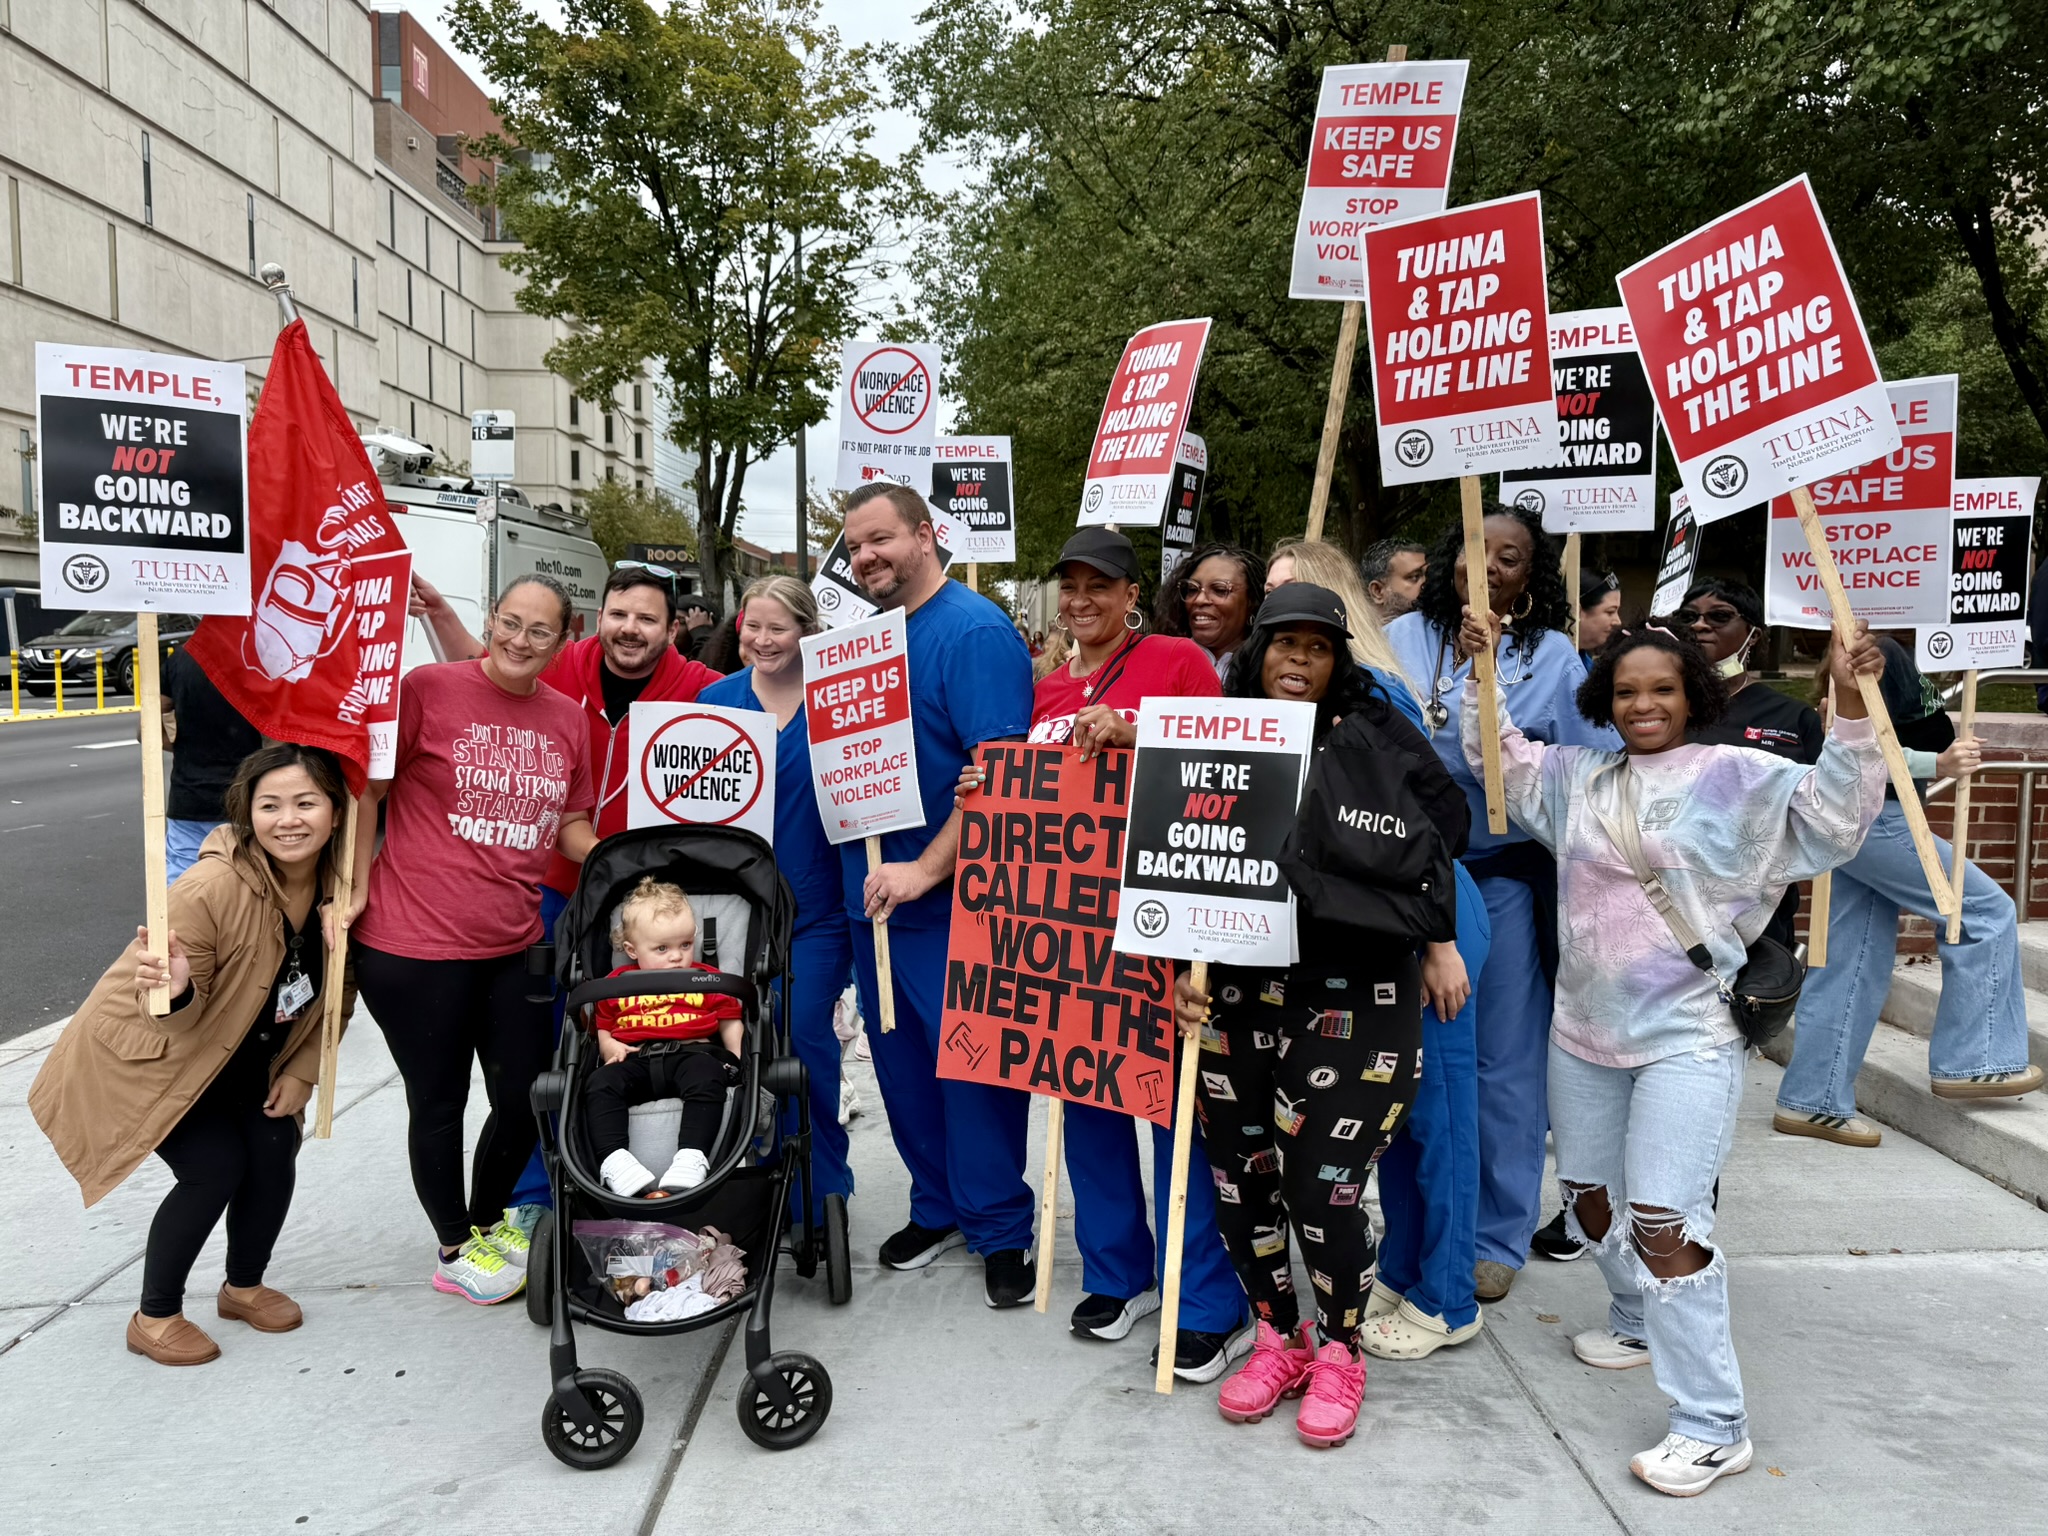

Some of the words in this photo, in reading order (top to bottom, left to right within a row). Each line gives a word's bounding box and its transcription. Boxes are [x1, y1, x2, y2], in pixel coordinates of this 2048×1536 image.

[1340, 81, 1443, 106] TEMPLE
[1324, 126, 1394, 150] KEEP
[1402, 126, 1442, 150] US
[1340, 154, 1414, 178] SAFE
[1346, 198, 1398, 215] STOP
[1317, 244, 1362, 260] VIOL
[1397, 228, 1506, 283] TUHNA
[1658, 224, 1784, 313] TUHNA
[1408, 286, 1430, 320] &
[1438, 273, 1500, 316] TAP
[1683, 306, 1709, 345] &
[1713, 270, 1784, 330] TAP
[1386, 308, 1532, 365] HOLDING
[1666, 295, 1832, 400] HOLDING
[1125, 341, 1182, 375] TUHNA
[65, 363, 221, 406] TEMPLE,
[860, 370, 924, 392] WORKPLACE
[1122, 378, 1135, 404] &
[1134, 372, 1170, 400] TAP
[1394, 362, 1452, 402] THE
[1458, 349, 1532, 392] LINE
[1554, 364, 1611, 390] WE'RE
[1683, 374, 1751, 434] THE
[1756, 334, 1843, 404] LINE
[865, 393, 916, 414] VIOLENCE
[1556, 392, 1600, 416] NOT
[100, 413, 188, 446] WE'RE
[1102, 402, 1177, 436] HOLDING
[1450, 416, 1542, 446] TUHNA
[1560, 417, 1610, 442] OING
[1762, 406, 1874, 460] TUHNA
[474, 427, 488, 440] 16
[1476, 441, 1511, 450] UNIVERSITY
[1512, 437, 1540, 446] HOSPITAL
[1771, 454, 1796, 469] TEMPLE
[1796, 438, 1839, 458] UNIVERSITY
[1840, 426, 1874, 442] HOSPITAL
[112, 446, 176, 474] NOT
[842, 440, 856, 452] IT'S
[857, 442, 872, 454] NOT
[874, 444, 892, 454] PART
[894, 445, 902, 455] OF
[904, 446, 917, 456] THE
[918, 446, 931, 456] JOB
[935, 445, 999, 458] TEMPLE,
[1097, 436, 1128, 464] THE
[1124, 432, 1170, 460] LINE
[1490, 445, 1529, 455] ASSOCIATION
[1787, 455, 1814, 470] NURSES
[1816, 438, 1862, 459] ASSOCIATION
[1886, 445, 1936, 472] US
[950, 468, 986, 481] WE'RE
[94, 474, 190, 506] GOING
[437, 493, 480, 505] FRONTLINE
[956, 483, 982, 496] NOT
[1112, 484, 1156, 500] TUHNA
[1562, 486, 1638, 505] TUHNA
[1813, 476, 1903, 506] SAFE
[1954, 492, 2022, 512] EMPLE,
[949, 498, 988, 511] GOING
[58, 502, 232, 539] BACKWARD
[1826, 522, 1892, 542] STOP
[966, 537, 1006, 547] TUHNA
[1957, 526, 2004, 547] WE'RE
[132, 560, 230, 583] TUHNA
[536, 558, 582, 578] nbc10.com
[1961, 550, 1997, 570] NOT
[564, 582, 596, 600] 62.com
[1796, 570, 1920, 591] VILENCE
[1951, 571, 2002, 592] GOING
[1952, 592, 2020, 614] CKWARD
[816, 629, 892, 669] TEMPLE
[1967, 630, 2016, 646] TUHNA
[813, 677, 866, 710] KEEP
[872, 667, 900, 694] US
[831, 696, 886, 730] SAFE
[1160, 714, 1286, 746] TEMPLE,
[453, 738, 537, 774] STAND
[542, 750, 564, 778] UP
[654, 744, 753, 774] WORKPLACE
[842, 738, 882, 760] STOP
[820, 752, 908, 787] WORKPLACE
[981, 747, 1063, 802] THE
[1180, 762, 1251, 790] WE'RE
[664, 774, 742, 802] VIOLENCE
[830, 776, 902, 806] VIOLENCE
[458, 789, 540, 823] STAND
[1183, 792, 1238, 820] NOT
[448, 813, 538, 850] TOGETHER
[1338, 805, 1406, 838] MRICU
[1168, 822, 1246, 852] GOING
[1136, 850, 1279, 886] BACKWARD
[1188, 907, 1272, 934] TUHNA
[691, 974, 720, 983] evenflo
[617, 1012, 702, 1028] STRON
[946, 960, 1070, 1032] MEET
[1076, 986, 1172, 1063] THE
[998, 1027, 1127, 1109] PACK
